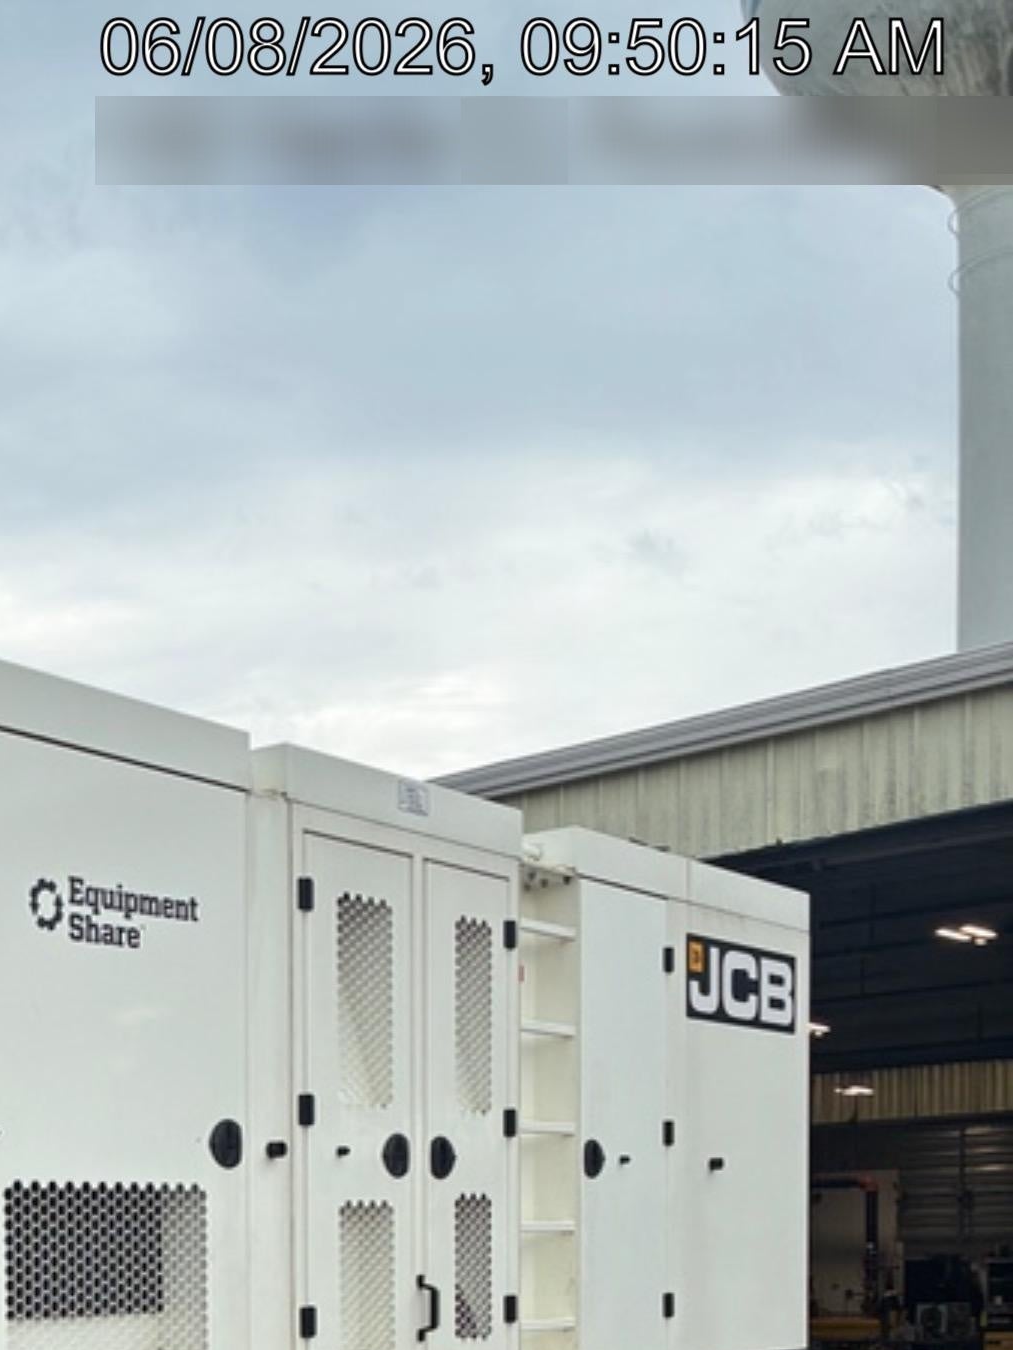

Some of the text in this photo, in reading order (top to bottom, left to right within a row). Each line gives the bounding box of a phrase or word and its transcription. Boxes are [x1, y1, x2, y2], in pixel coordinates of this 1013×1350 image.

[67, 875, 199, 922] Equipment
[68, 912, 141, 949] Share
[689, 944, 793, 1027] JCB
